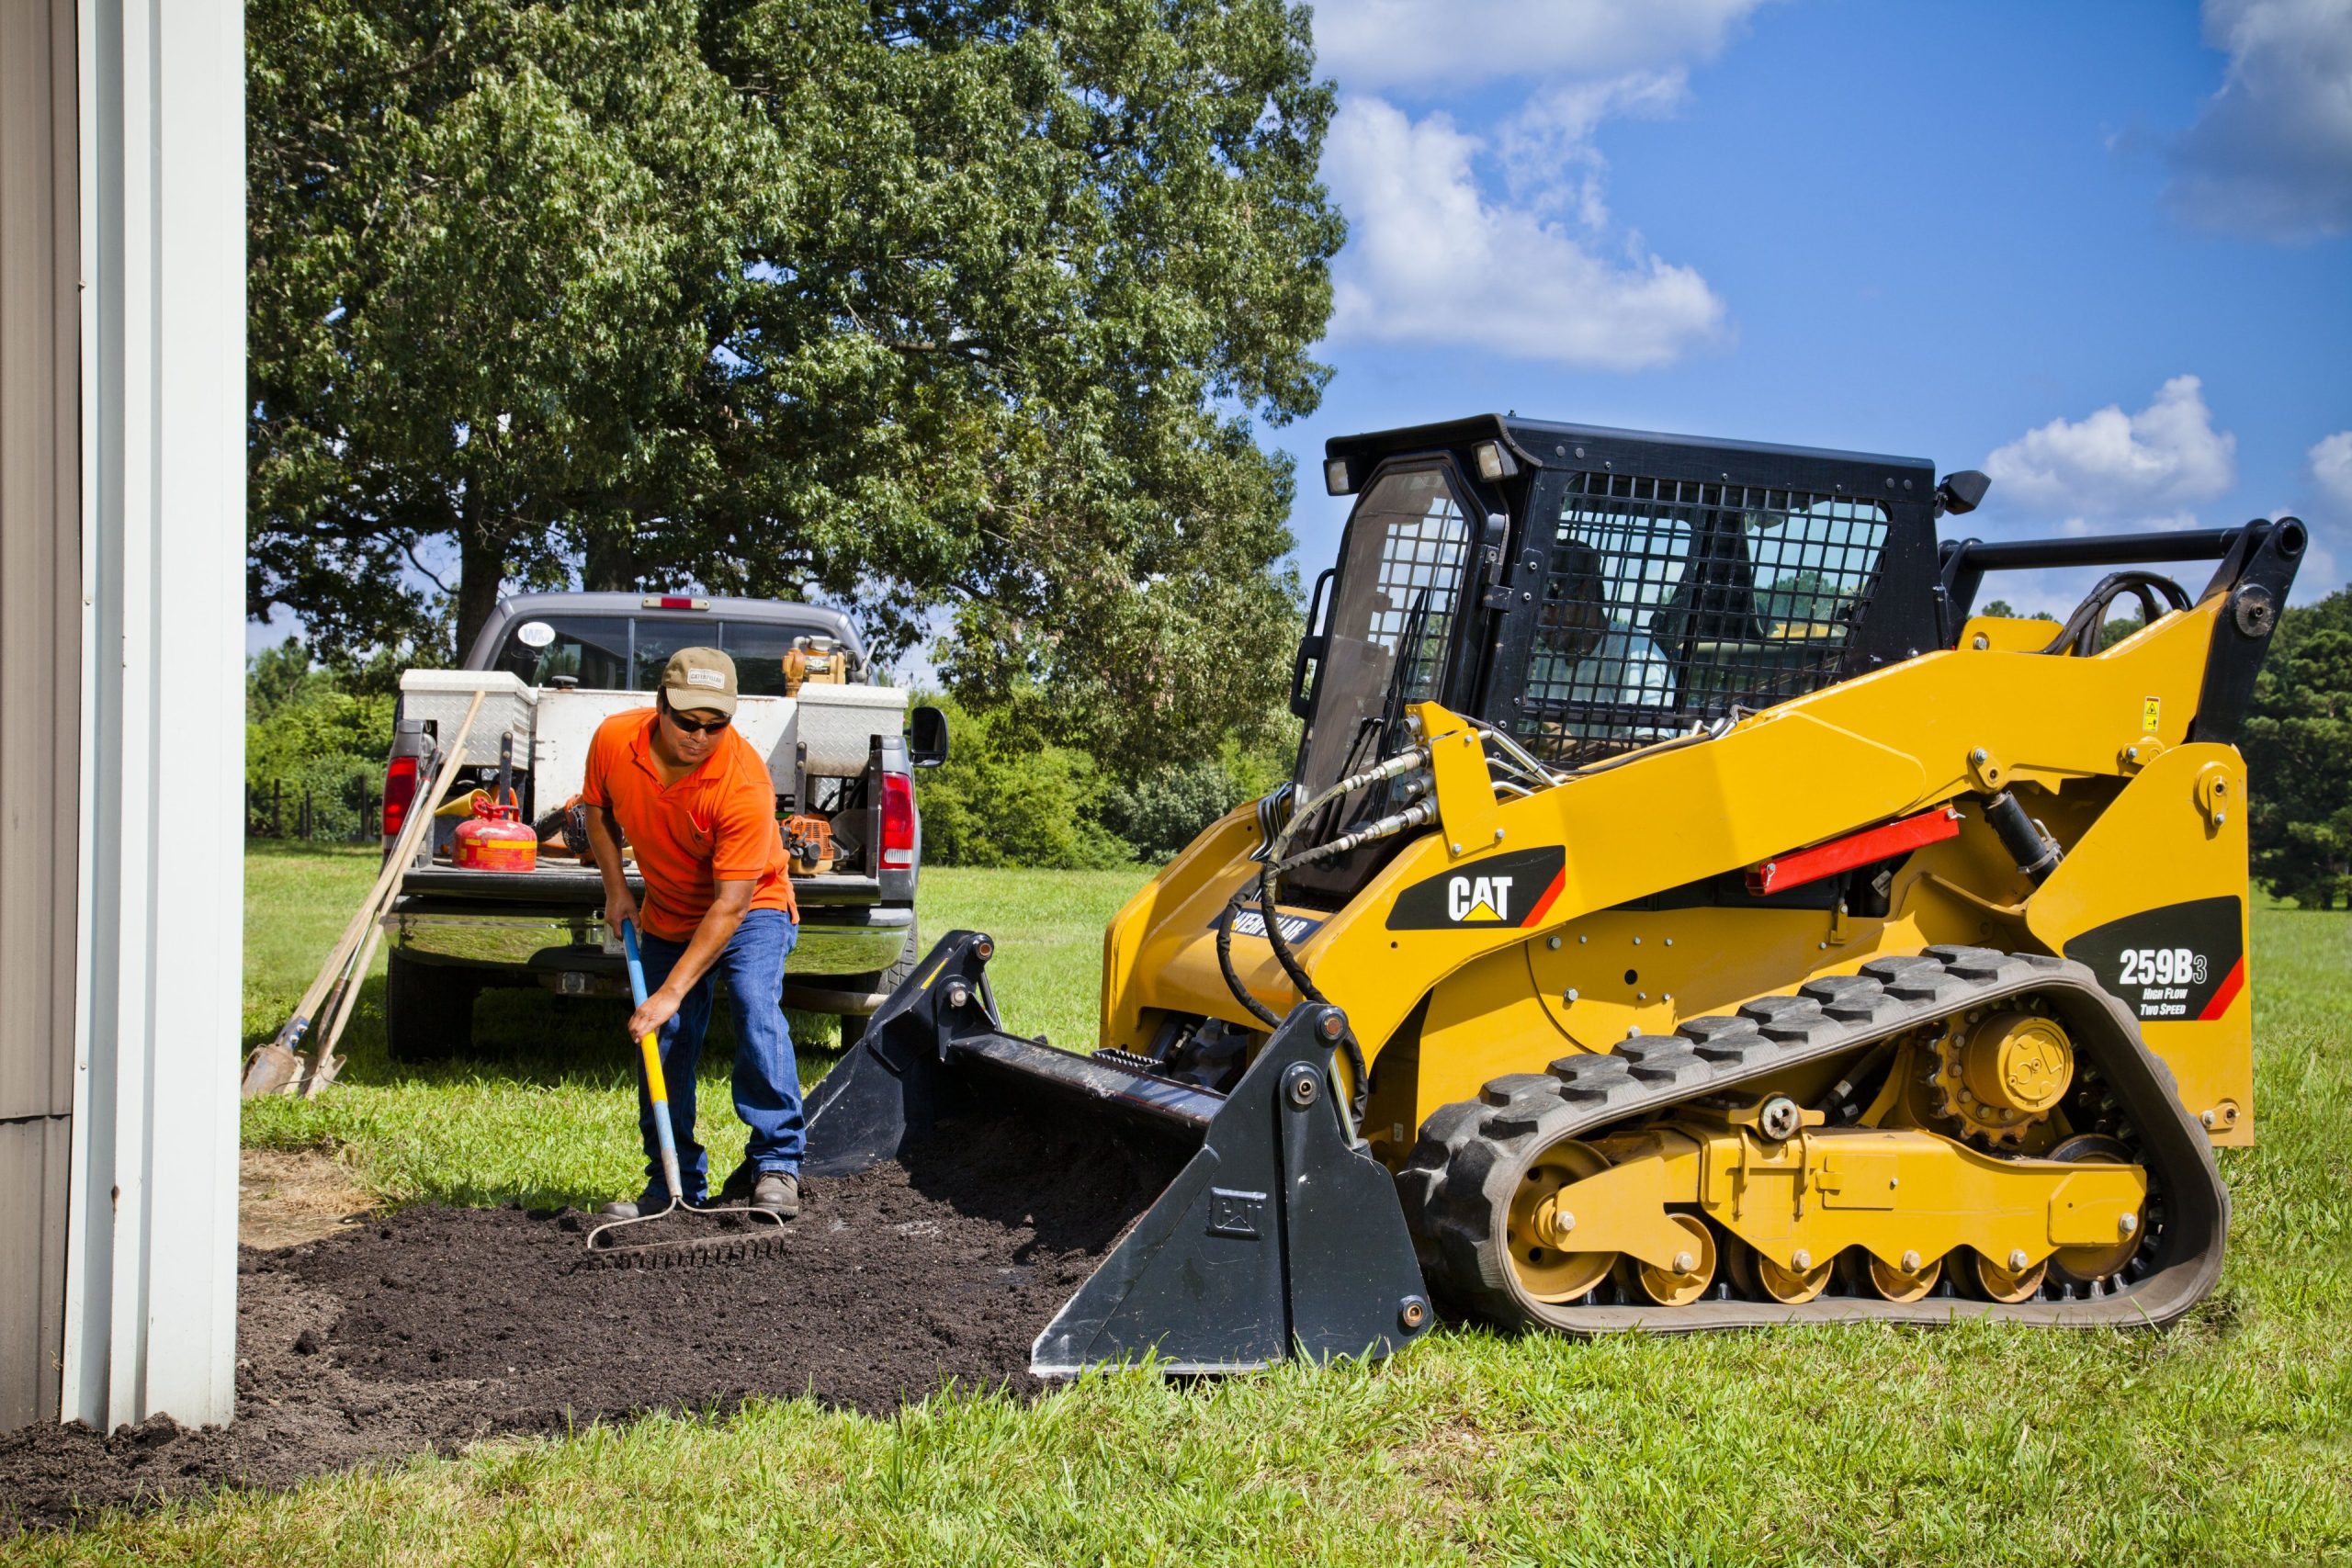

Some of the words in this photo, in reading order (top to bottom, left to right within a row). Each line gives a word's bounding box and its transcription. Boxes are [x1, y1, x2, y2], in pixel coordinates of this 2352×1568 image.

[1449, 876, 1512, 921] CAT
[1230, 909, 1308, 942] ATERPLAR
[1215, 1197, 1263, 1233] CAT
